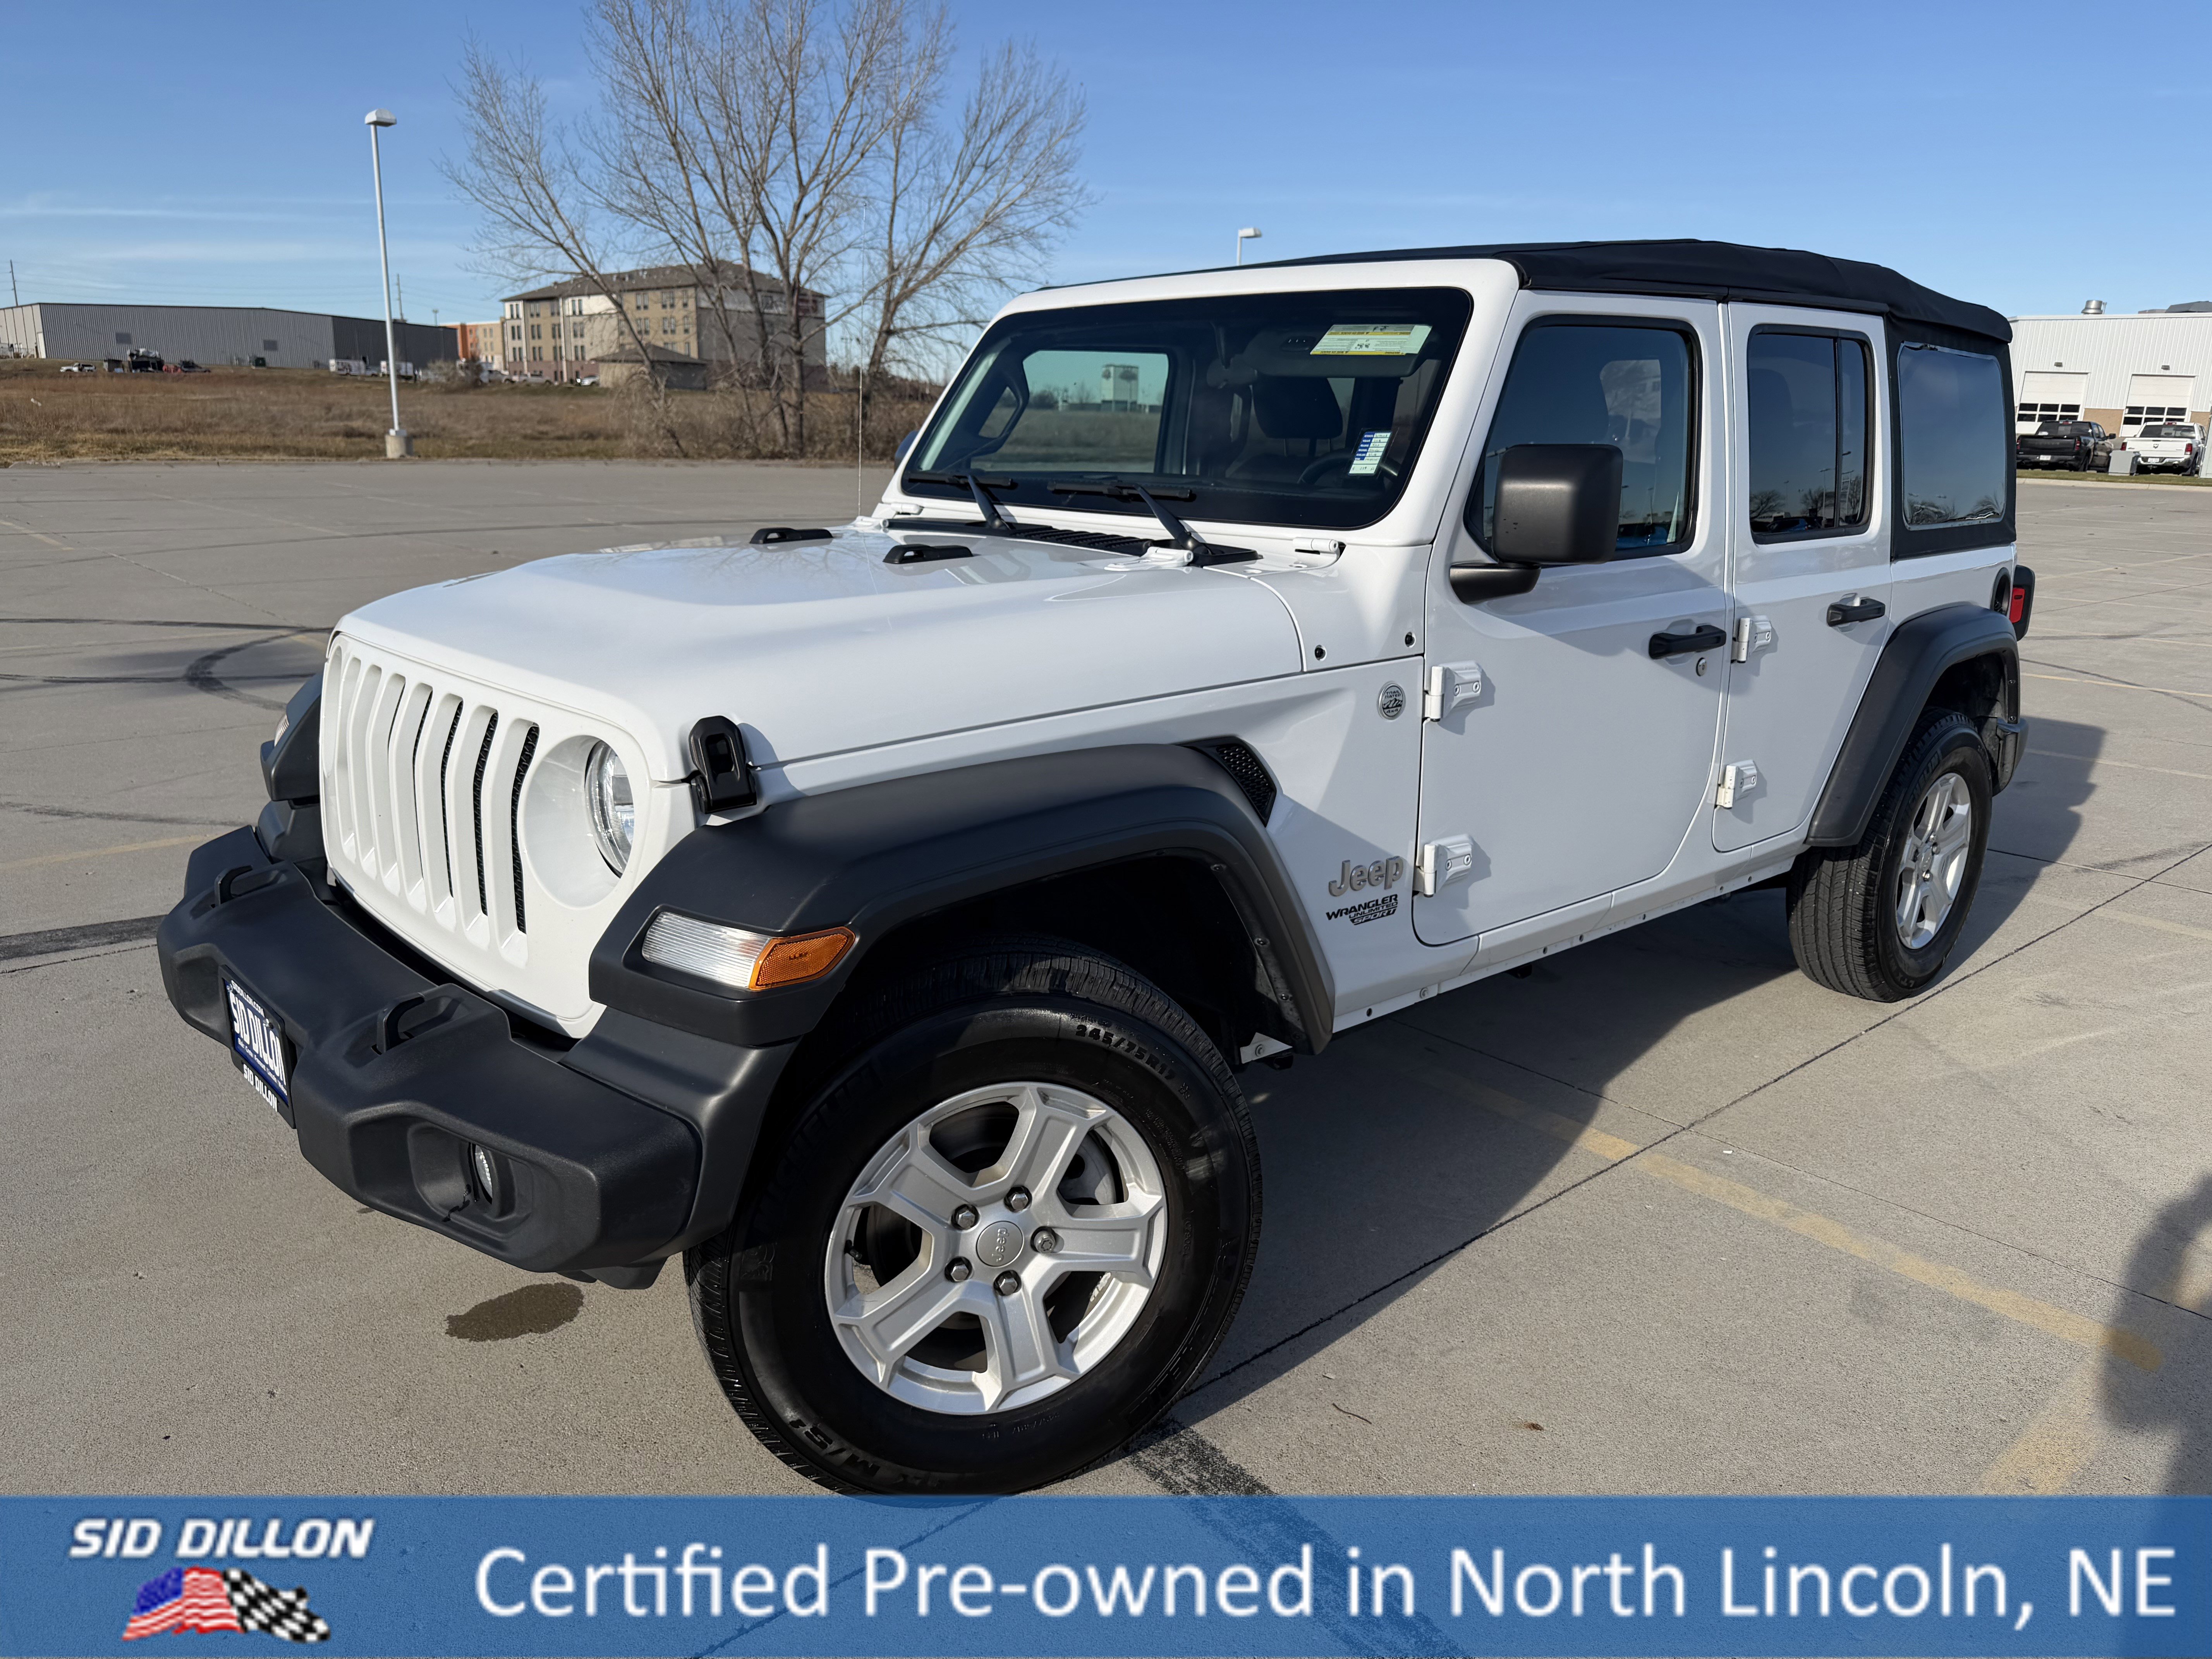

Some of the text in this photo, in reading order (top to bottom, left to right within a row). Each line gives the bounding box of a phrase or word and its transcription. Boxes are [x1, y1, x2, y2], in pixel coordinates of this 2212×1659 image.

[1328, 855, 1404, 897] Jeep
[1326, 893, 1398, 921] WRANGLER
[1349, 902, 1398, 919] UNLIMITED
[1353, 908, 1396, 924] SPORT
[229, 991, 287, 1086] SID DILLON
[1075, 1024, 1176, 1080] 245/75R17
[243, 1063, 278, 1112] SID DILLON
[991, 1227, 1010, 1262] Jeep
